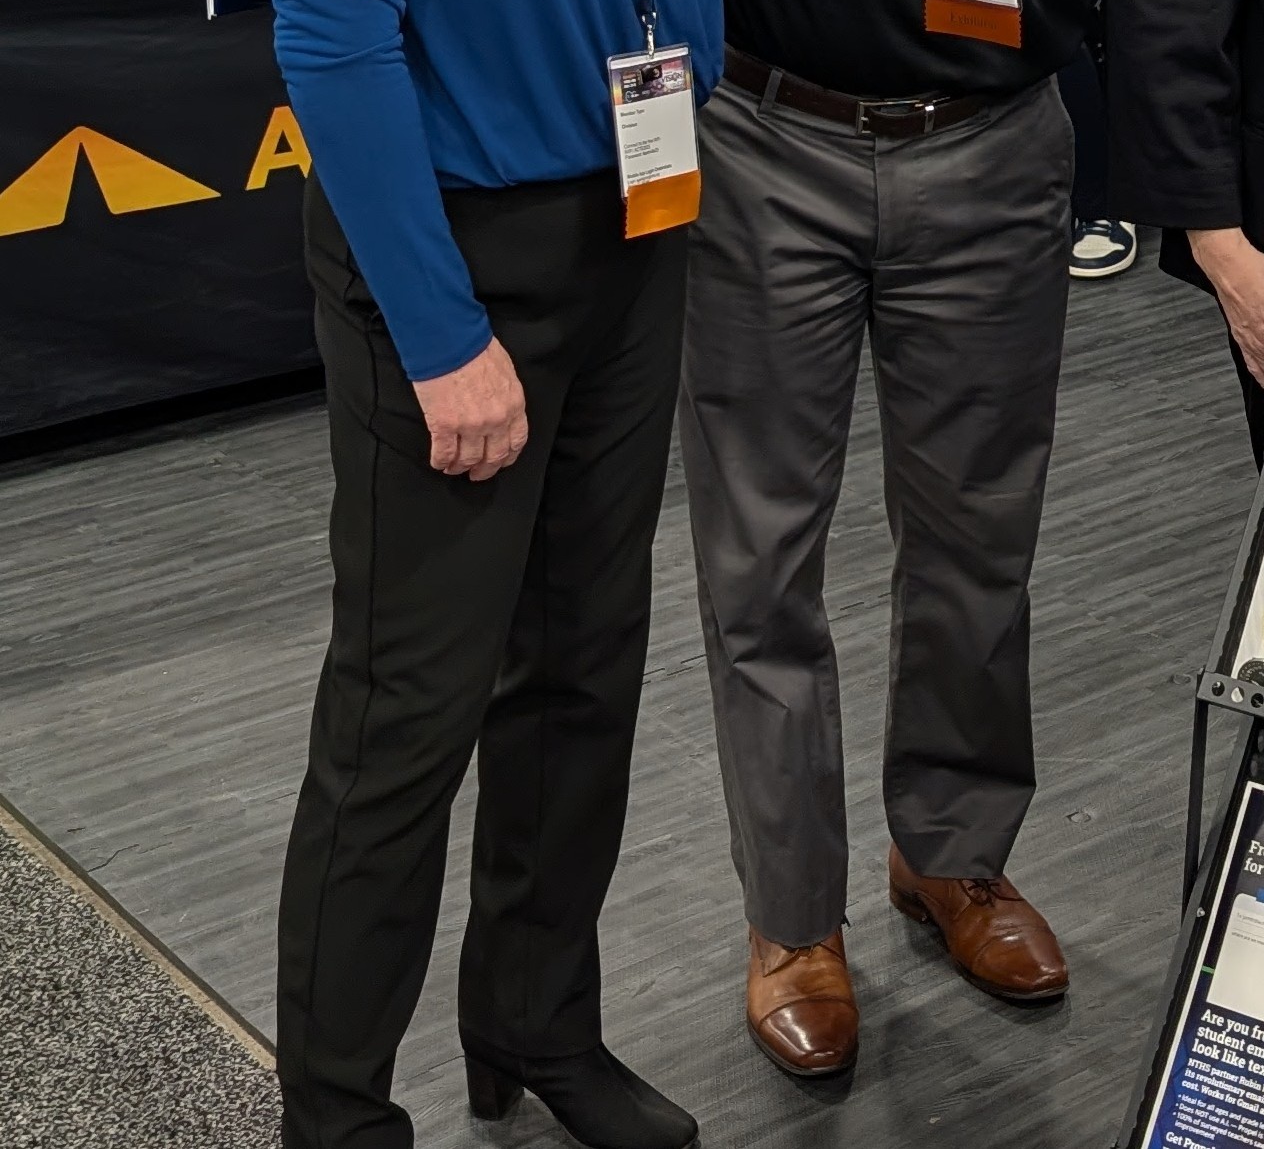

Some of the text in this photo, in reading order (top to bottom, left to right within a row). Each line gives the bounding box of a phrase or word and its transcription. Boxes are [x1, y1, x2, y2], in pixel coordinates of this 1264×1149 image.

[1244, 857, 1264, 876] for
[1201, 1009, 1224, 1027] Are
[1225, 1016, 1249, 1036] you
[1197, 1026, 1246, 1051] student
[1192, 1039, 1220, 1060] look
[1221, 1048, 1246, 1069] like
